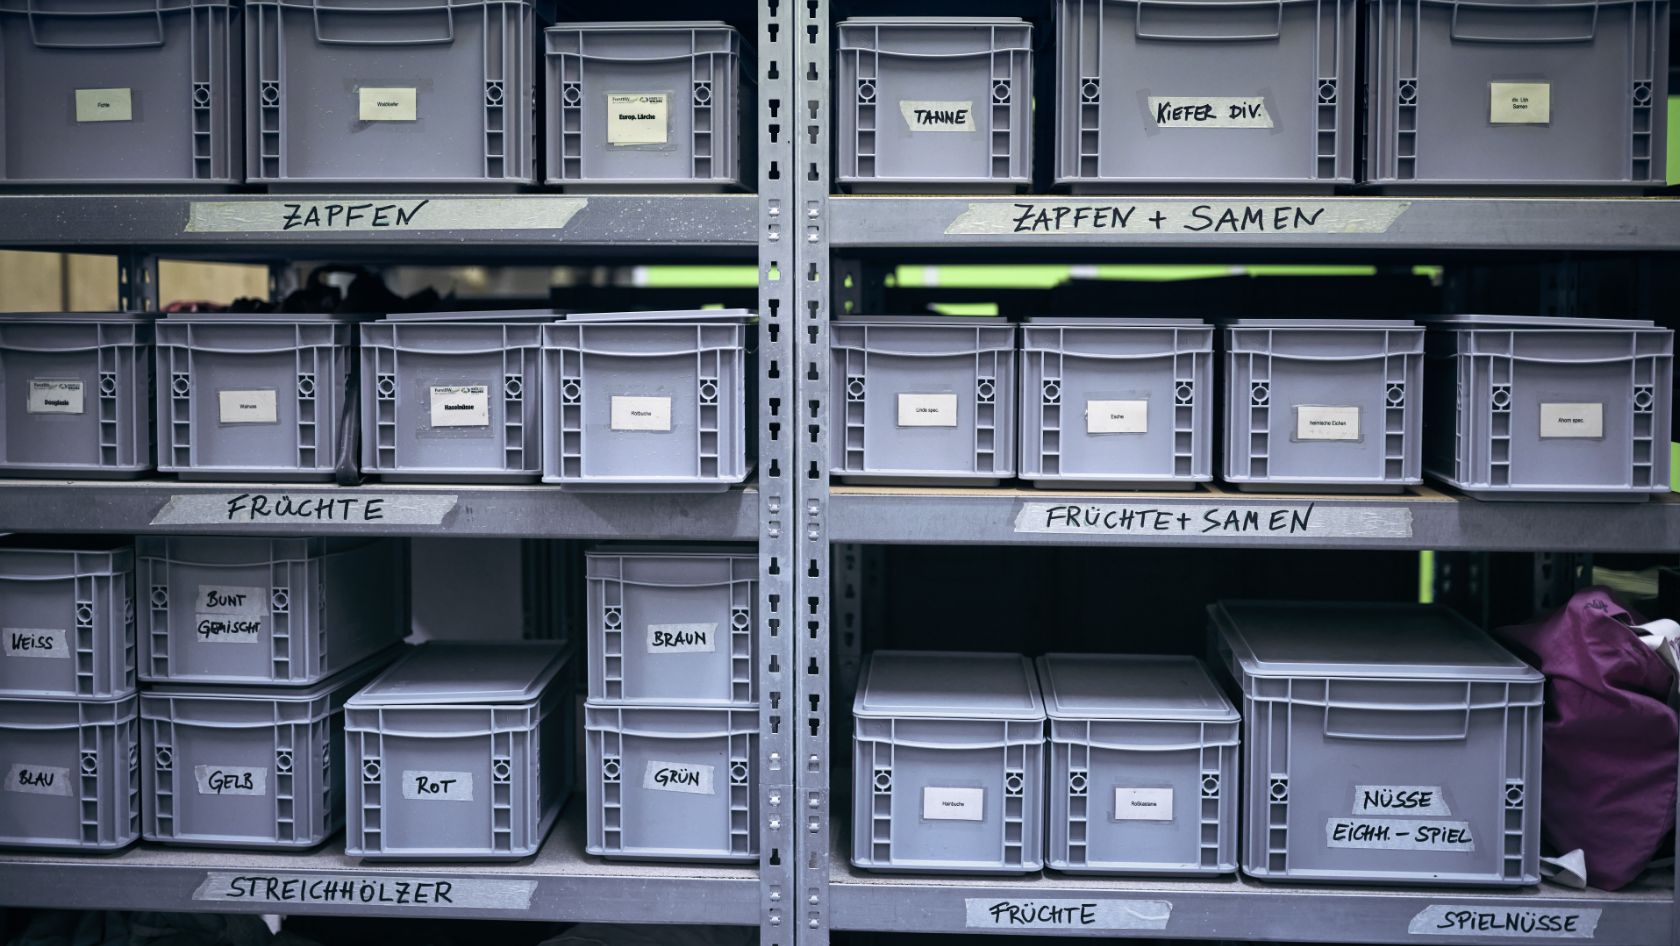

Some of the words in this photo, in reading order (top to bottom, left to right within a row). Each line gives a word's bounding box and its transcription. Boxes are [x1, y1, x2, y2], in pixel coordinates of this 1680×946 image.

[618, 113, 637, 121] Europ.
[914, 110, 969, 124] TANNE
[282, 198, 430, 230] ZAPFEN
[1013, 203, 1136, 233] ZAPFEN
[1149, 211, 1167, 229] +
[1184, 205, 1325, 231] SAMEN
[226, 497, 385, 520] FRÜCHTE
[1202, 502, 1314, 533] SAMEN
[206, 591, 247, 608] BUNT
[652, 631, 706, 647] BRAUN
[18, 769, 54, 787] BLAU
[209, 771, 254, 795] GELB
[655, 768, 700, 786] GRÜN
[1364, 789, 1433, 809] NÜSSE
[225, 877, 454, 905] STREICHHÖLZER
[989, 901, 1097, 924] FRÜCHTE
